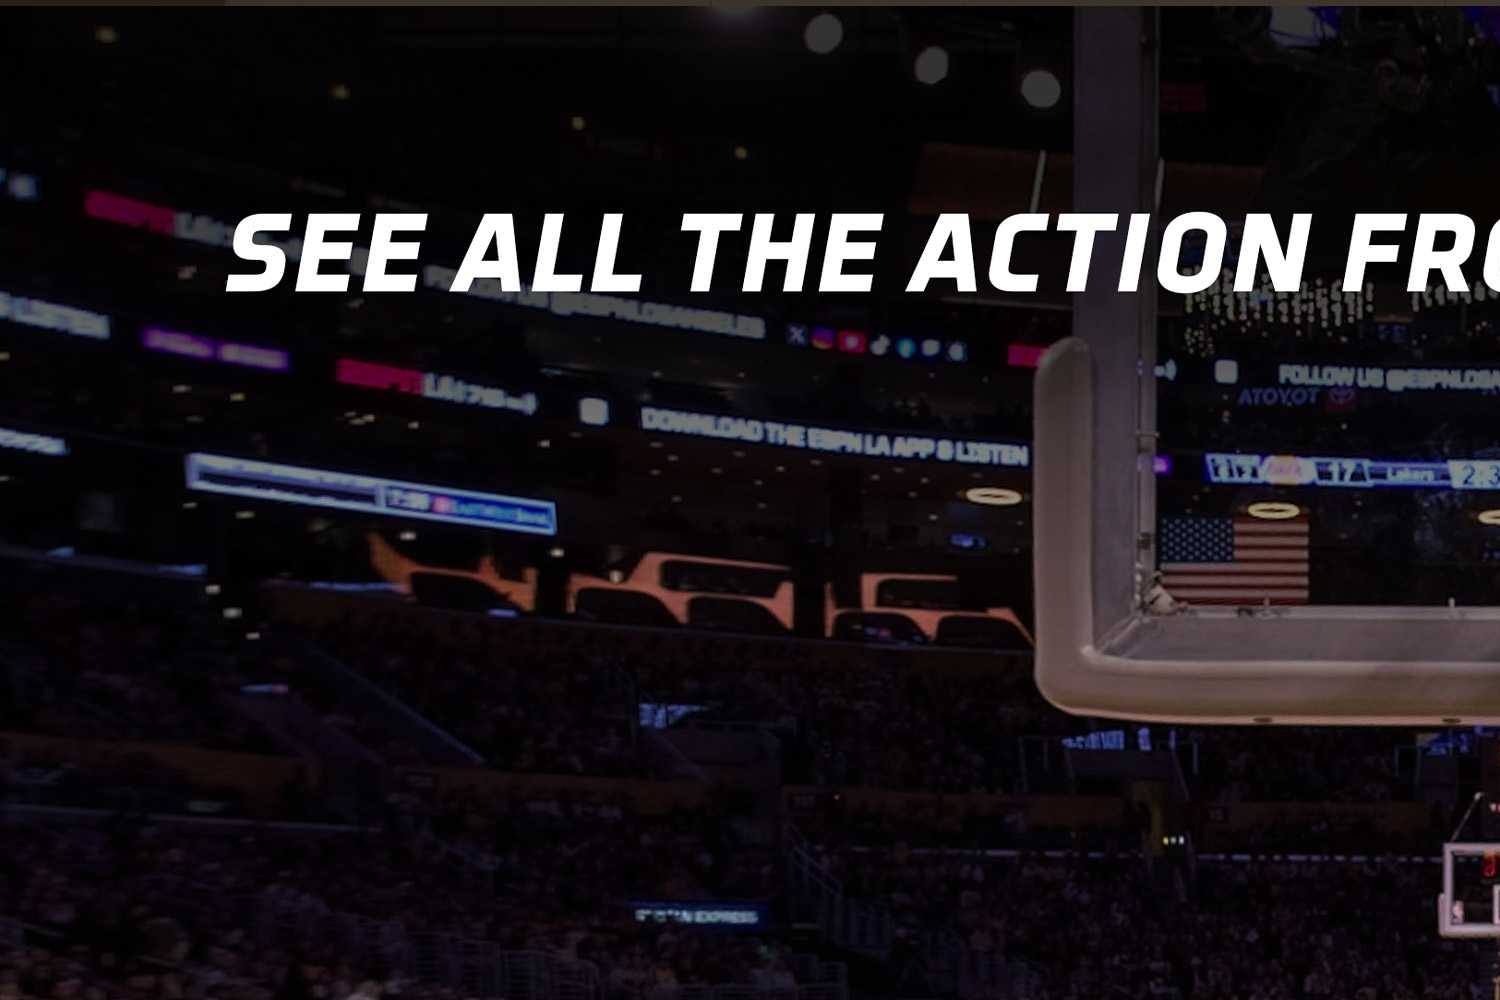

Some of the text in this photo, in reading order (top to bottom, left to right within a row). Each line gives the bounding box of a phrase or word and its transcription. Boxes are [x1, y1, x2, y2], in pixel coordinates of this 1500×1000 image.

[1279, 364, 1355, 387] FOLLOW
[641, 406, 761, 443] DOWNLOAD
[763, 422, 806, 447] THE
